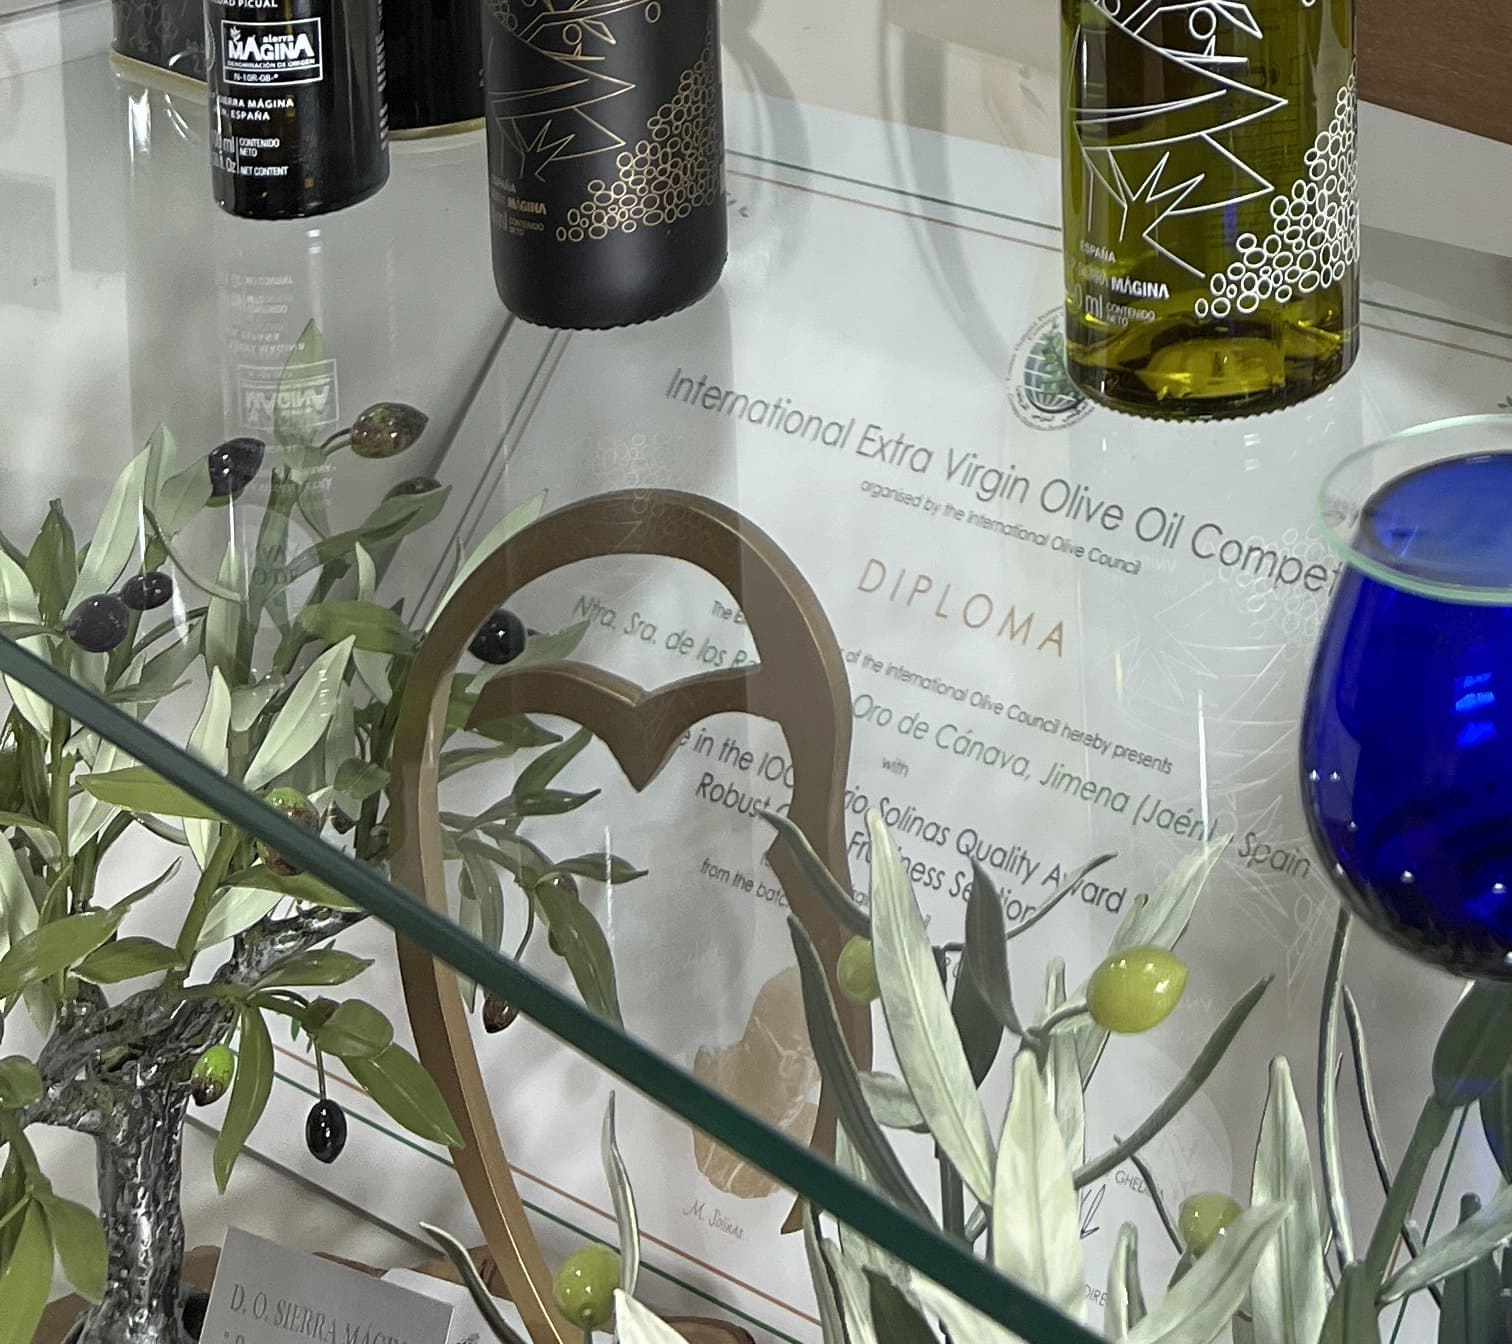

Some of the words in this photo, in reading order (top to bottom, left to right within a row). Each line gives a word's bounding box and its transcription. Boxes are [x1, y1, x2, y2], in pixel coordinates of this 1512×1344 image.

[231, 109, 271, 122] ESPAÑA
[248, 96, 295, 109] MÁGINA
[1080, 239, 1117, 263] ESPAÑA
[1085, 293, 1103, 320] ml
[1111, 275, 1170, 300] MÁGINA
[665, 367, 856, 450] International
[855, 423, 934, 474] Extra
[946, 447, 1031, 503] Virgin
[1040, 478, 1125, 532] Olive
[1135, 506, 1185, 550] Oil
[1051, 534, 1086, 559] Olive
[1088, 546, 1143, 576] Council
[857, 557, 1066, 658] DIPLOMA
[624, 611, 657, 645] Sra.
[665, 629, 695, 655] de
[696, 637, 727, 668] los
[693, 727, 715, 758] in
[718, 738, 754, 772] the
[969, 690, 1005, 717] Olive
[1006, 702, 1062, 736] Council
[1061, 723, 1112, 756] hereby
[1111, 742, 1175, 777] presents
[852, 693, 894, 729] Oro
[897, 712, 930, 741] de
[935, 723, 1032, 781] Cánava,
[1040, 761, 1131, 814] Jimena
[1237, 830, 1311, 881] Spain
[877, 796, 951, 847] Solinas
[955, 827, 1041, 885] Quality
[700, 856, 731, 884] from
[731, 868, 755, 892] the
